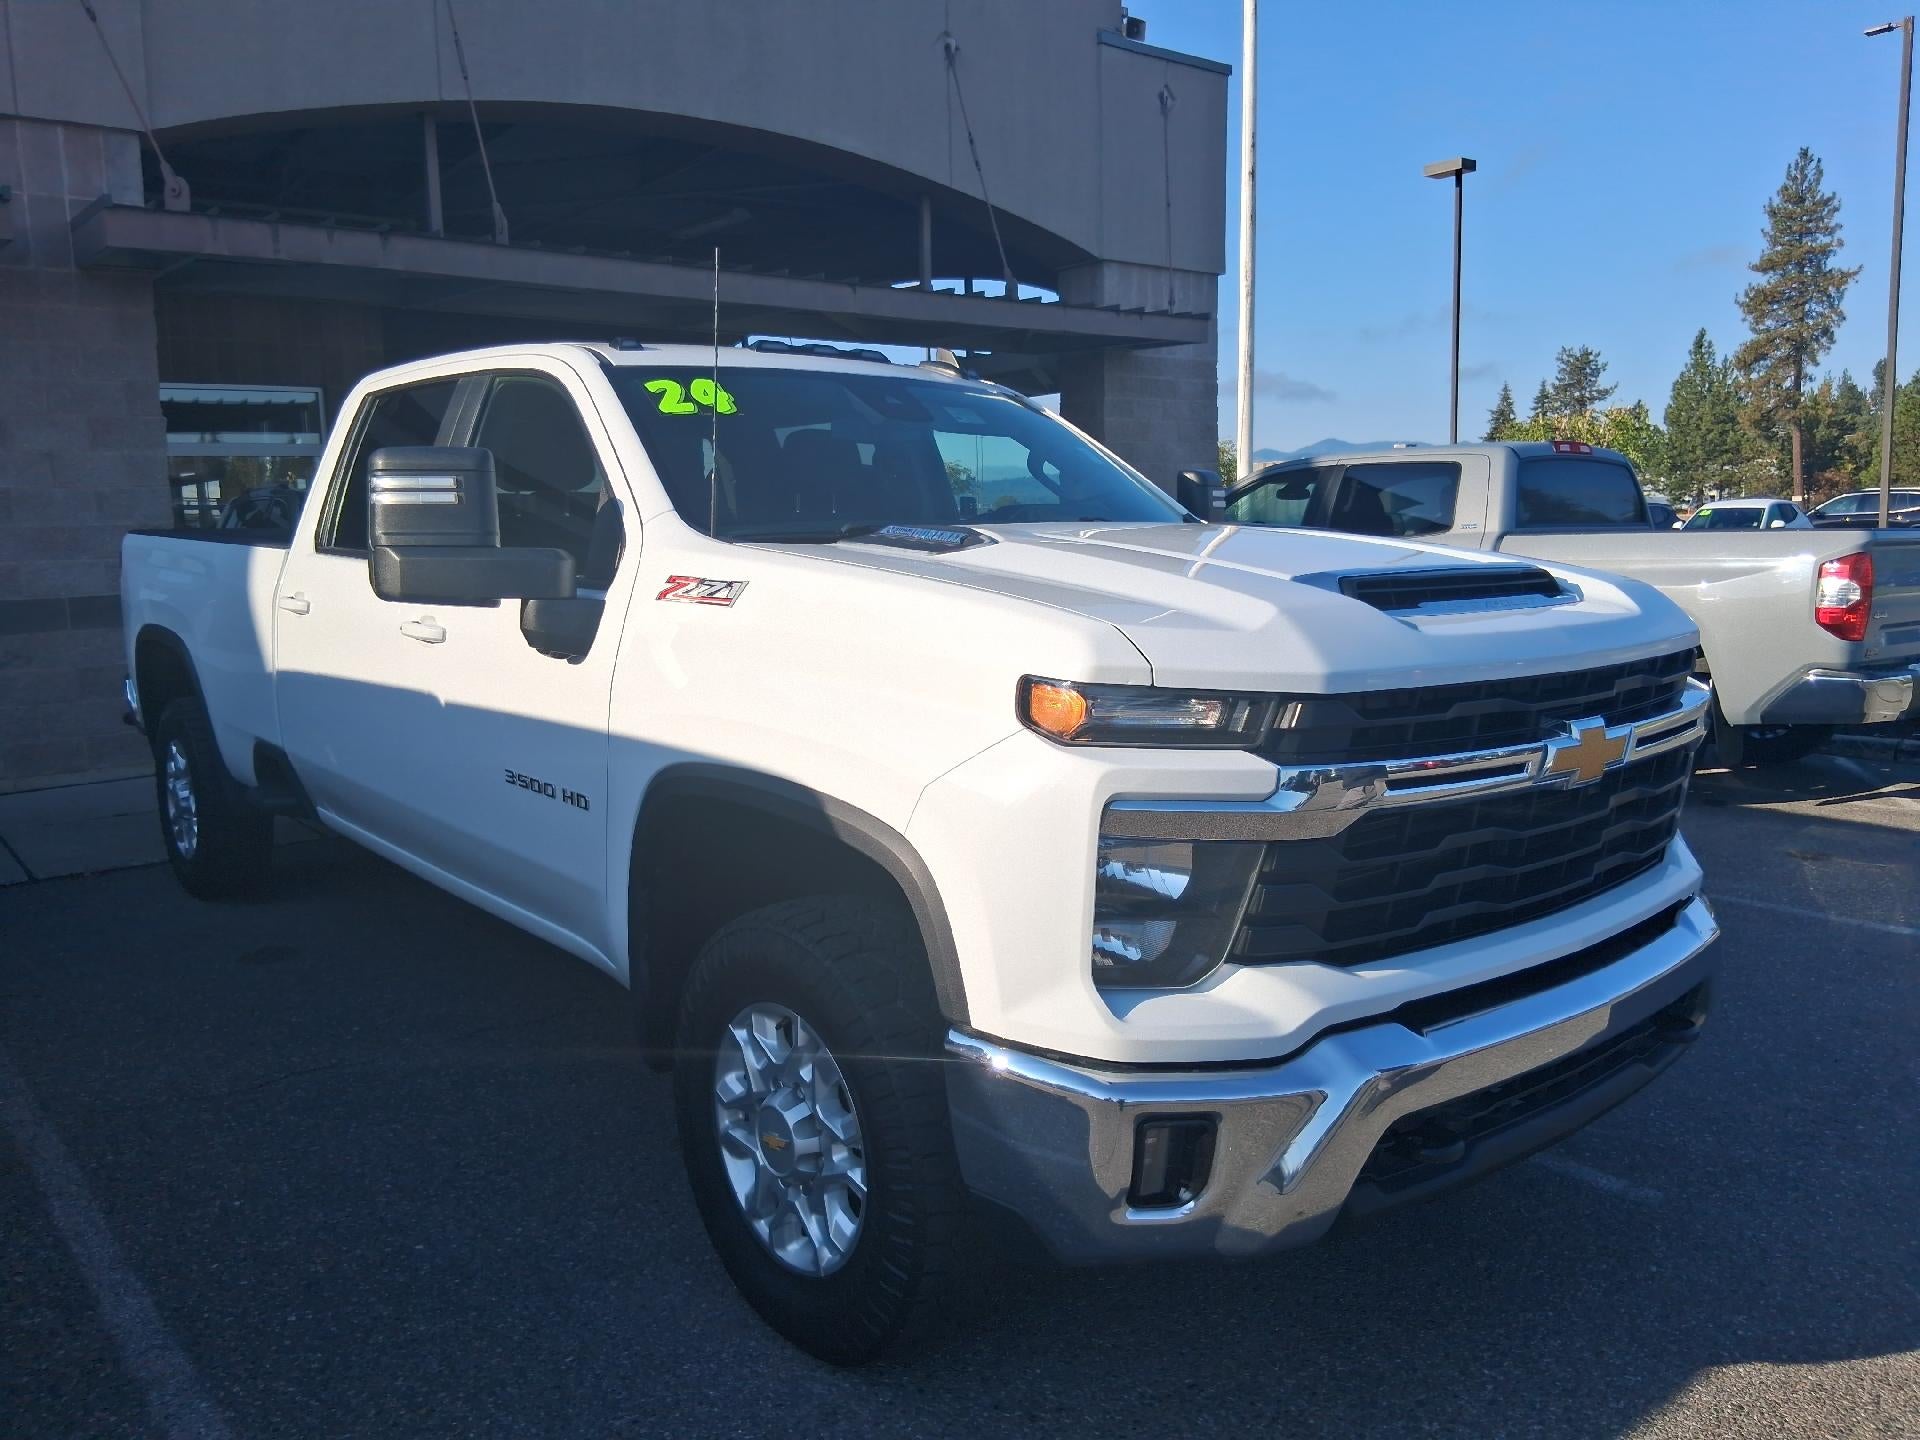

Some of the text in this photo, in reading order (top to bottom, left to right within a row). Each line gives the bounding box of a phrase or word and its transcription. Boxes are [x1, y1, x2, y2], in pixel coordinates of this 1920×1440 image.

[655, 575, 749, 608] Z71
[504, 768, 590, 811] 3500 HD
